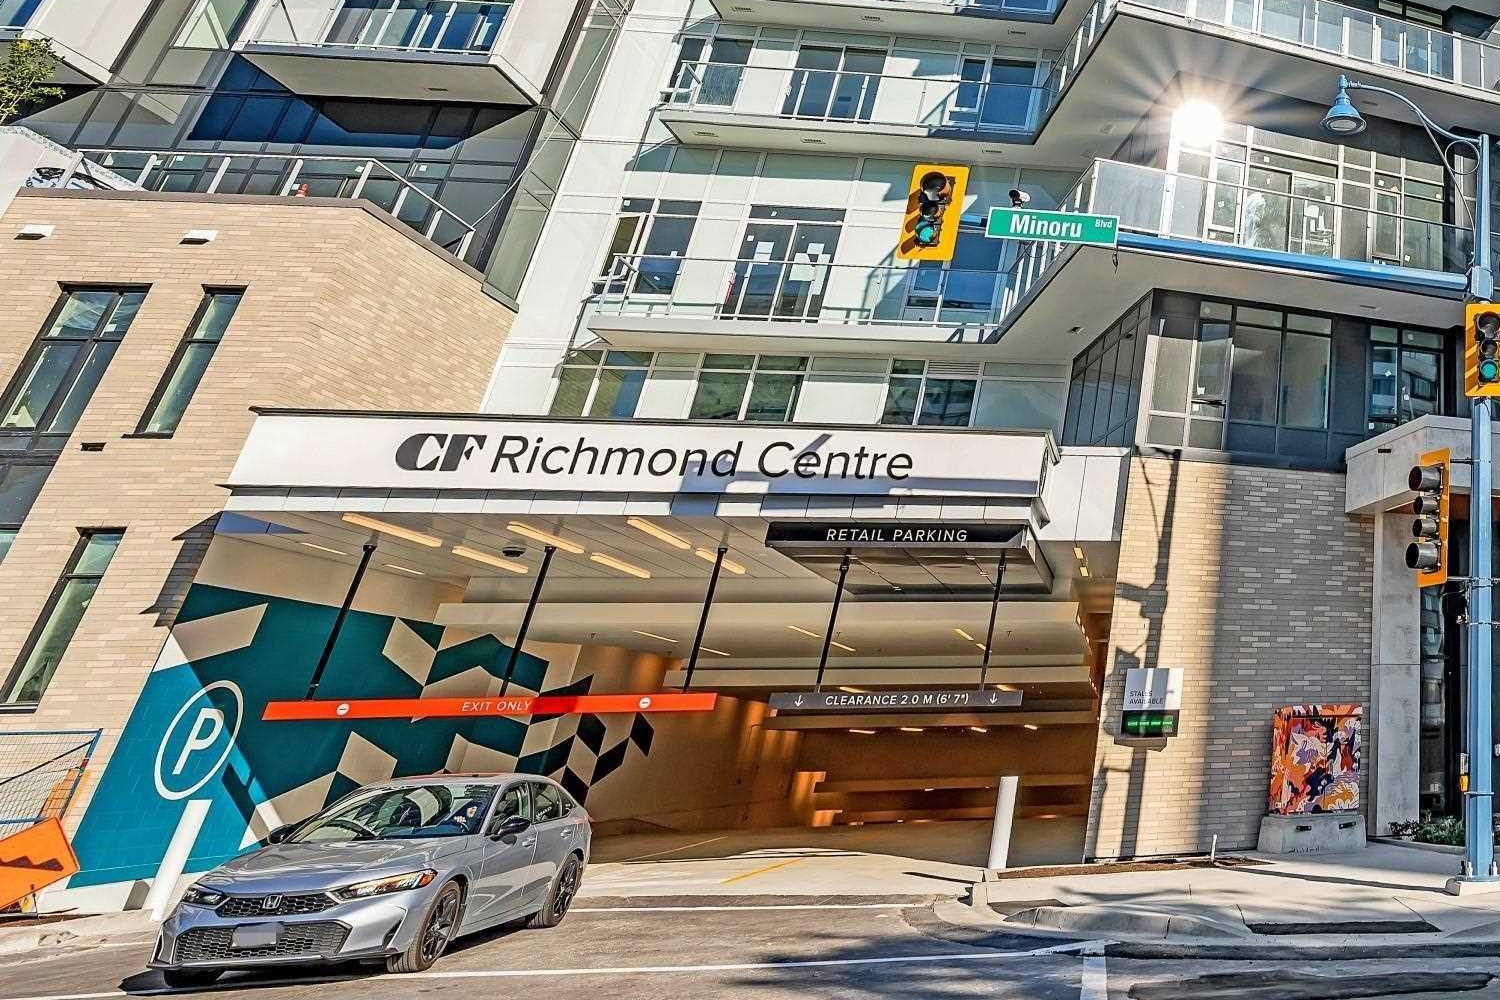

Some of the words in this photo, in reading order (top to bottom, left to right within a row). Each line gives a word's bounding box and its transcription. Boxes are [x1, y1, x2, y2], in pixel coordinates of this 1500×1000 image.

[1010, 214, 1083, 238] Minoru
[1094, 218, 1113, 228] Blvd
[395, 433, 488, 472] CF
[490, 435, 744, 479] Richmond
[826, 528, 885, 541] RETAIL
[892, 529, 968, 542] PARKING
[461, 701, 491, 712] EXIT
[496, 700, 532, 711] ONLY
[825, 695, 898, 706] CLEARANCE
[922, 694, 933, 704] M
[172, 707, 225, 775] P
